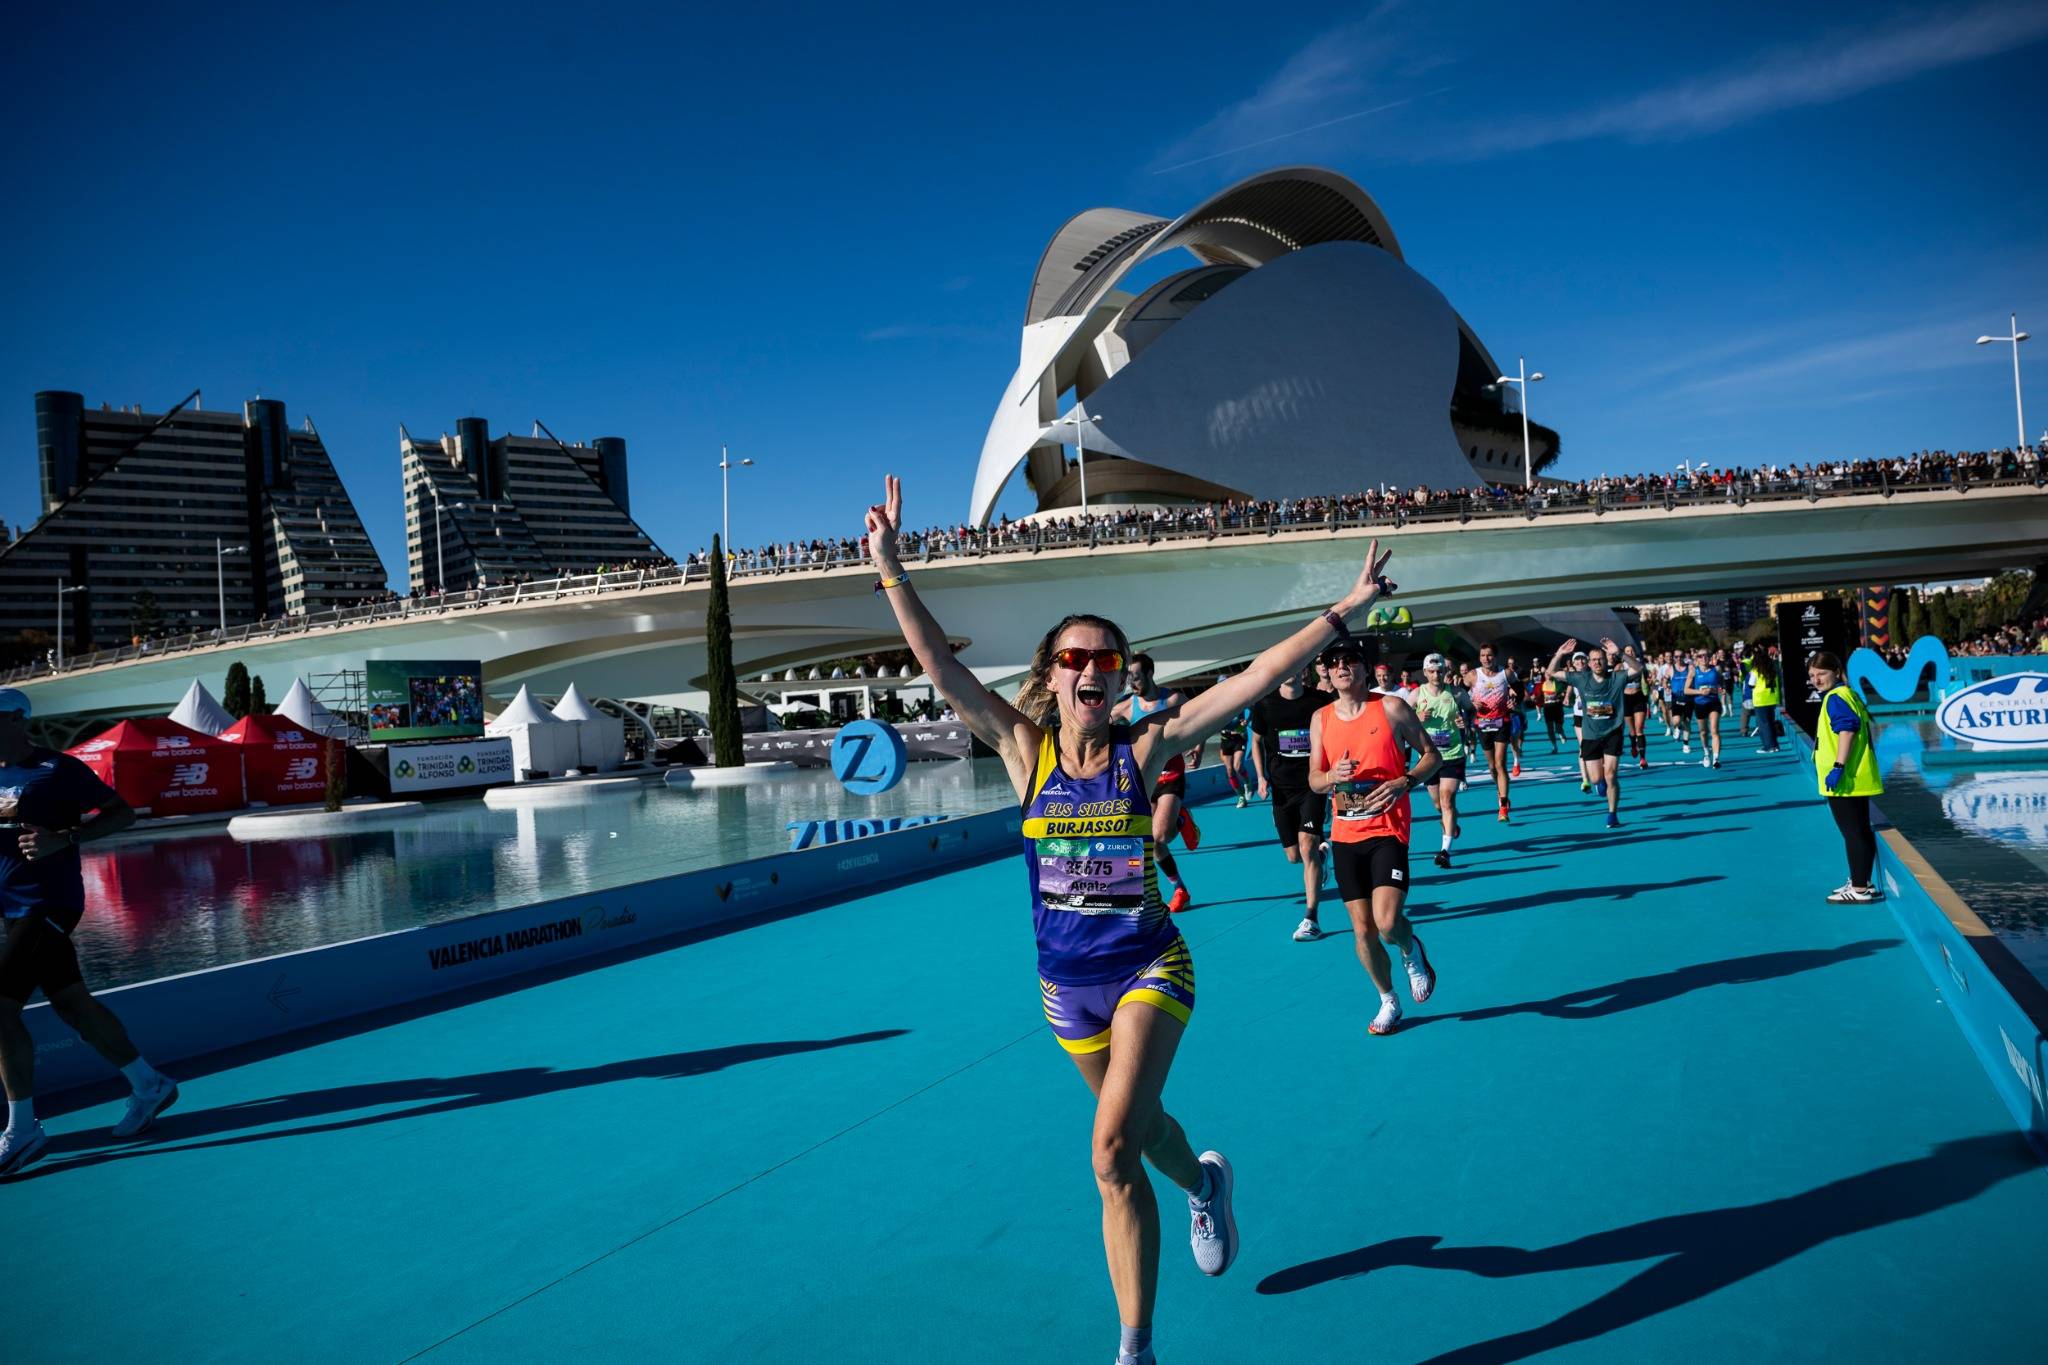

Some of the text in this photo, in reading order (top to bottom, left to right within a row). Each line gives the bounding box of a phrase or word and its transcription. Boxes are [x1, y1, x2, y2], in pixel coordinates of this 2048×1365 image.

[1980, 698, 2033, 708] CENTRAL
[289, 742, 317, 750] balance
[171, 748, 206, 756] balance
[417, 761, 455, 771] TRINIDAD
[477, 755, 511, 766] TRINIDAD
[418, 770, 455, 779] ALFONSO
[478, 764, 511, 774] ALFONSO
[277, 781, 325, 792] new balance
[160, 787, 218, 798] new balance
[1044, 798, 1132, 817] ELS SITGES
[1047, 818, 1133, 835] BURJASSOT
[785, 815, 949, 852] ZUR
[1066, 860, 1113, 876] 35675
[428, 935, 504, 970] VALENCIA
[506, 917, 582, 953] MARATHON
[34, 1038, 73, 1054] FONSO
